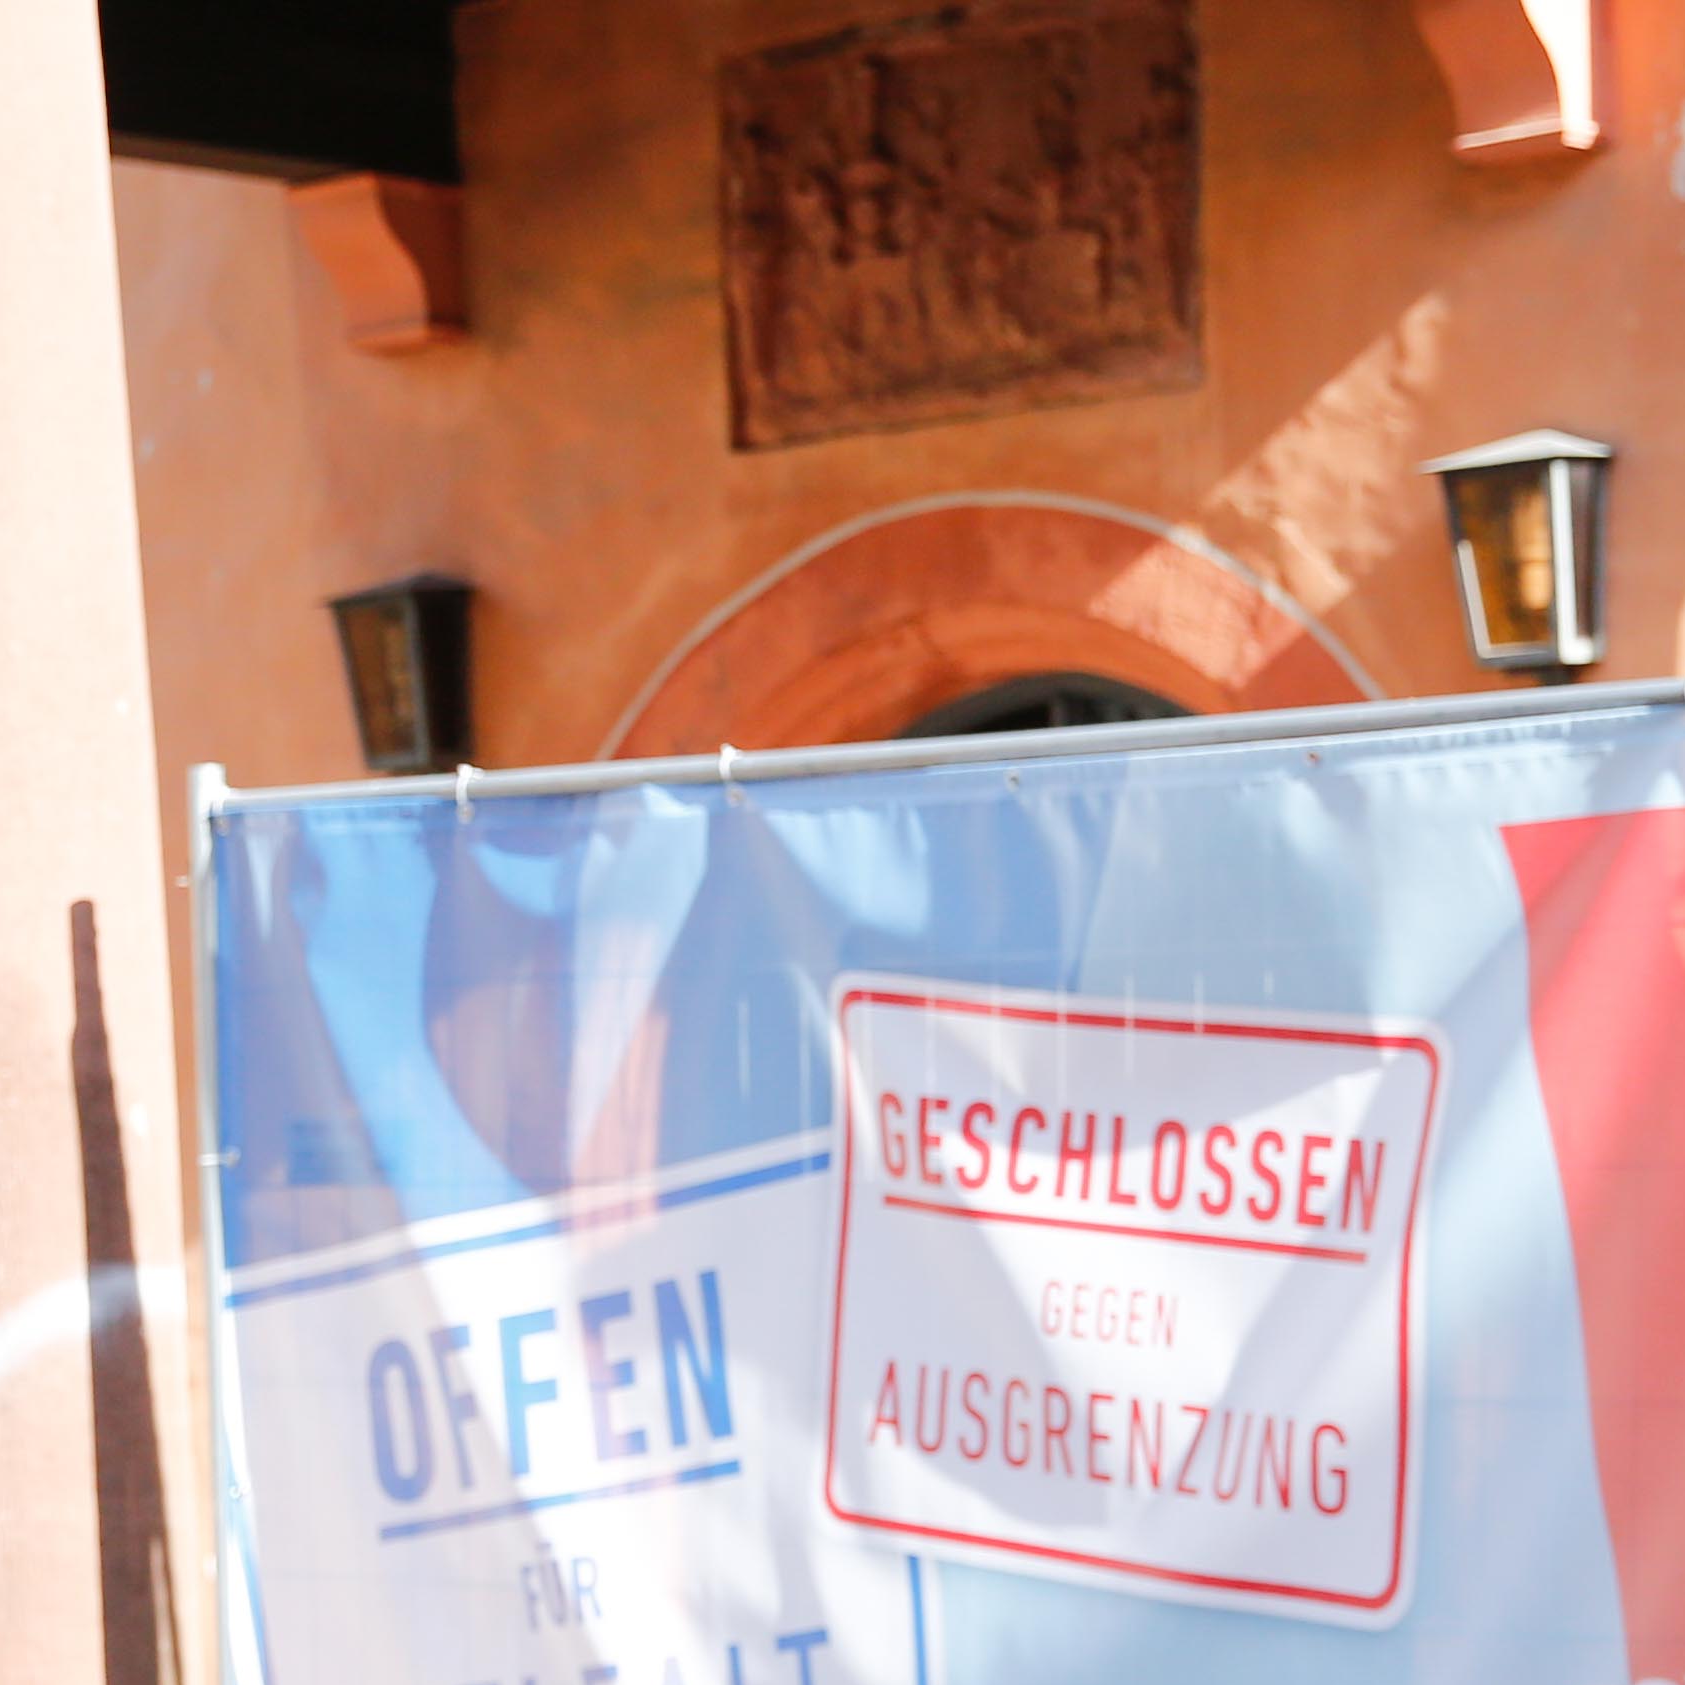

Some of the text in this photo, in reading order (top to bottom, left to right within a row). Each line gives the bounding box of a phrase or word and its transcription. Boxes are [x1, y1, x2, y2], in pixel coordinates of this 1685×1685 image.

[880, 1092, 1385, 1233] GESCHLOSSEN
[1040, 1280, 1178, 1349] GEGEN
[368, 1269, 734, 1504] OFFEN
[868, 1360, 1349, 1516] AUSGRENZUNG
[520, 1541, 603, 1632] FÜR
